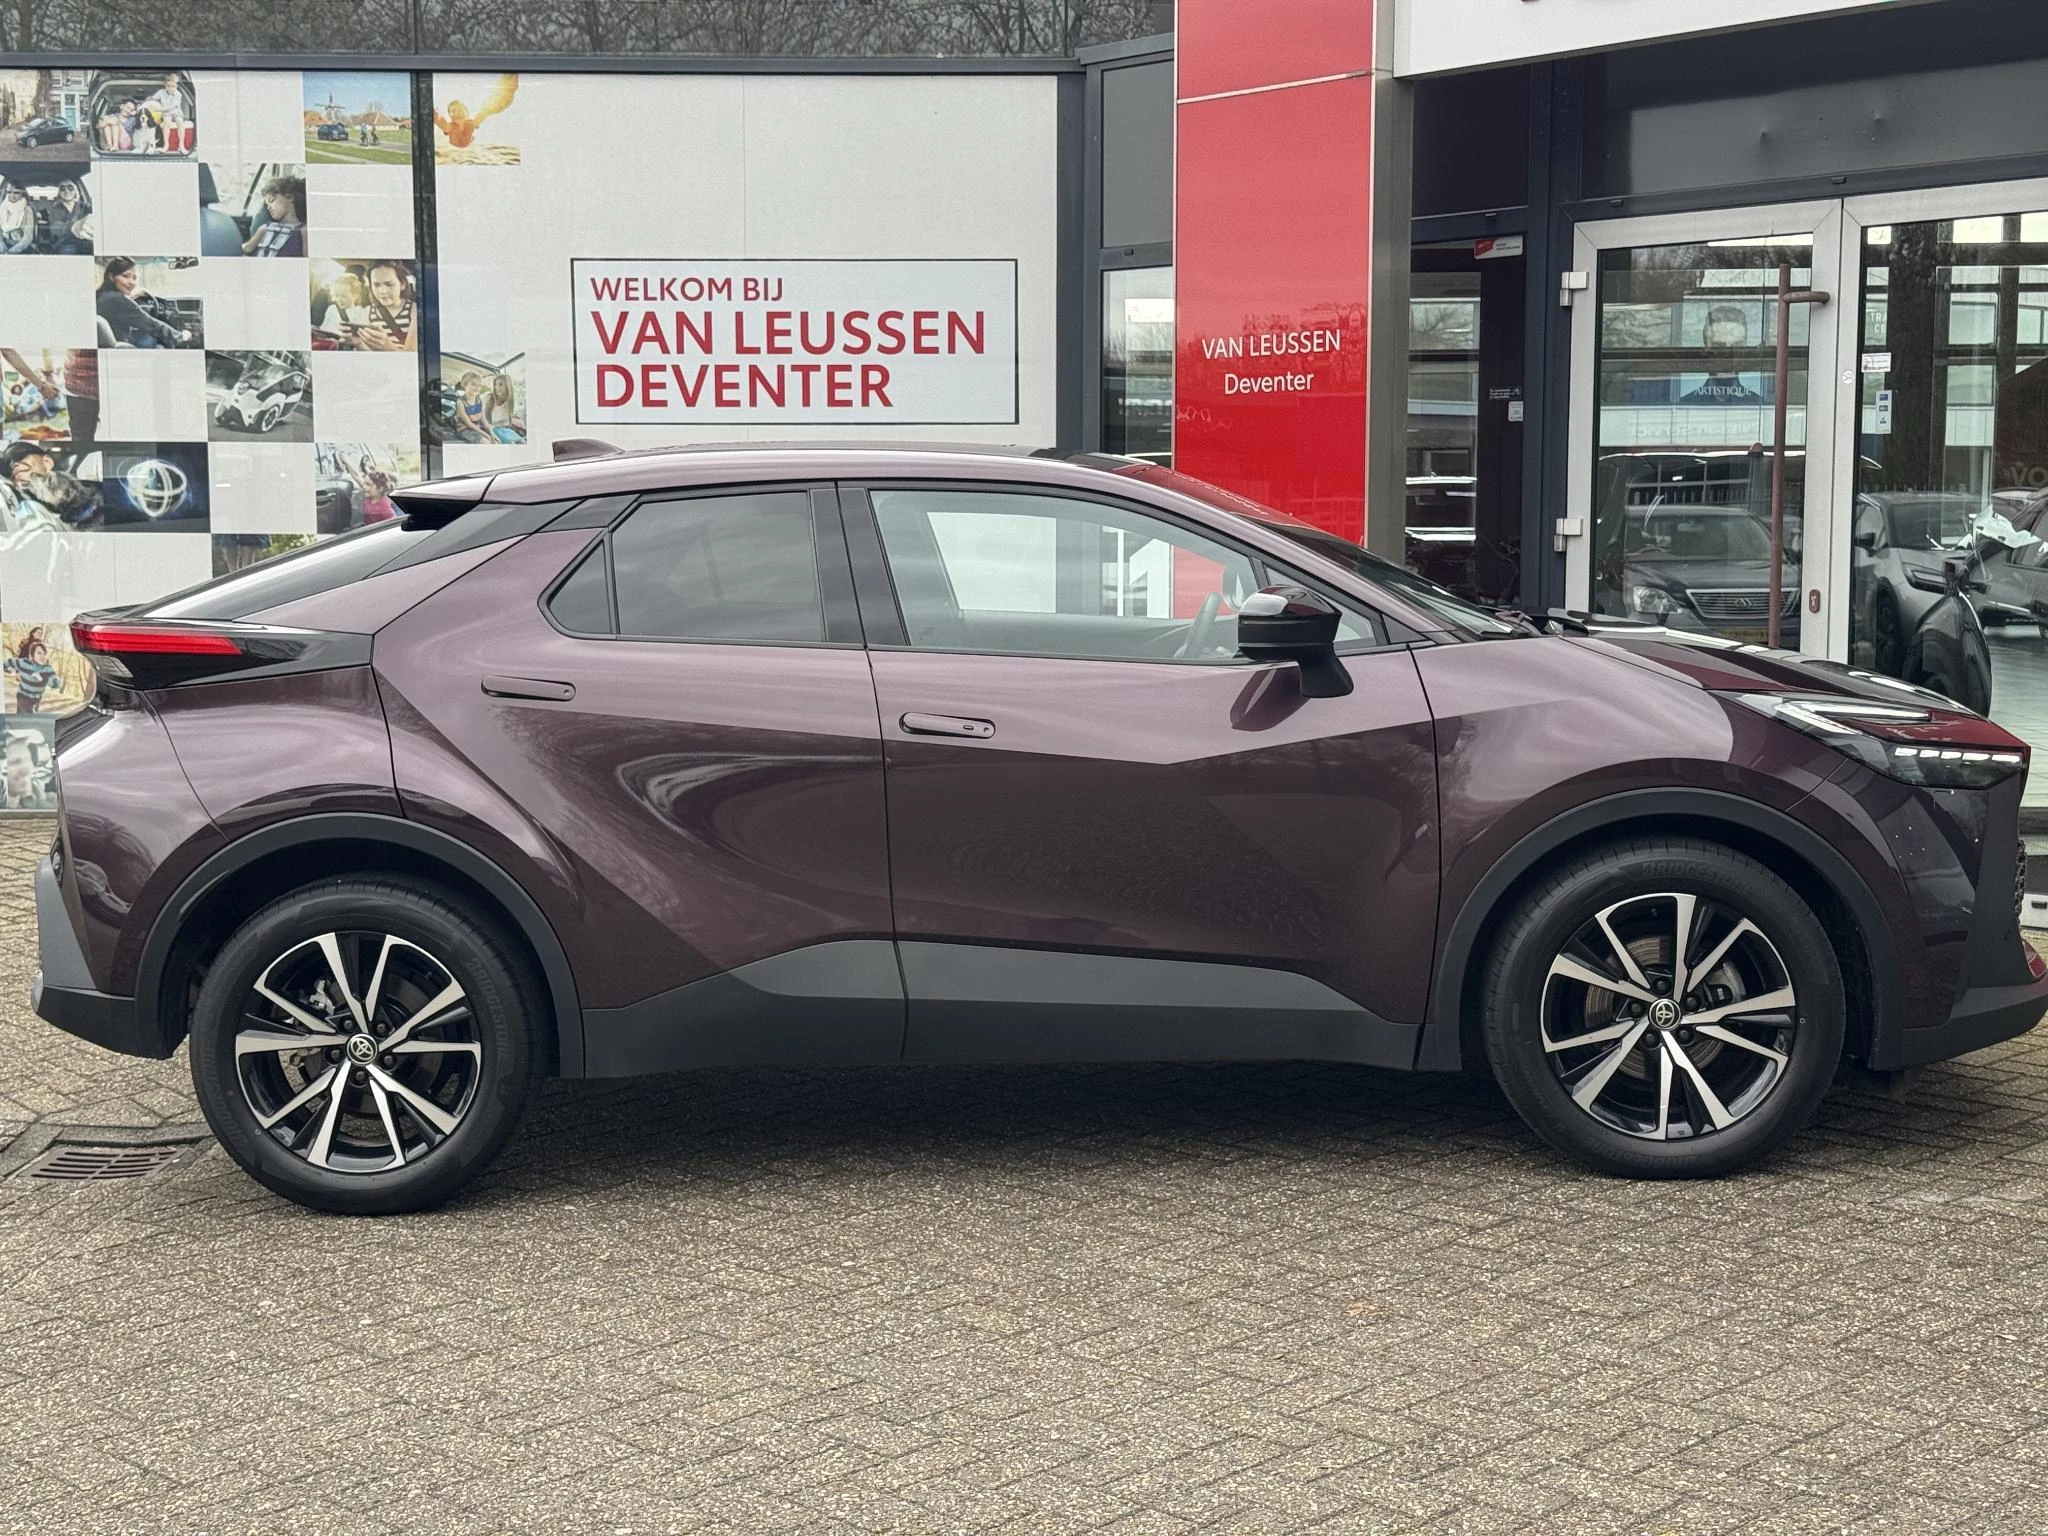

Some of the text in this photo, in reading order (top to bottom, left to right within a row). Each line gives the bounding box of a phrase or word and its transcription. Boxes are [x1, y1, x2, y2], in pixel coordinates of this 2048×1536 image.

[590, 277, 783, 301] WELKOM BIJ
[590, 310, 984, 355] VAN LEUSSEN
[1202, 329, 1341, 359] VAN LEUSSEN
[596, 364, 894, 407] DEVENTER
[1224, 371, 1315, 395] Deventer
